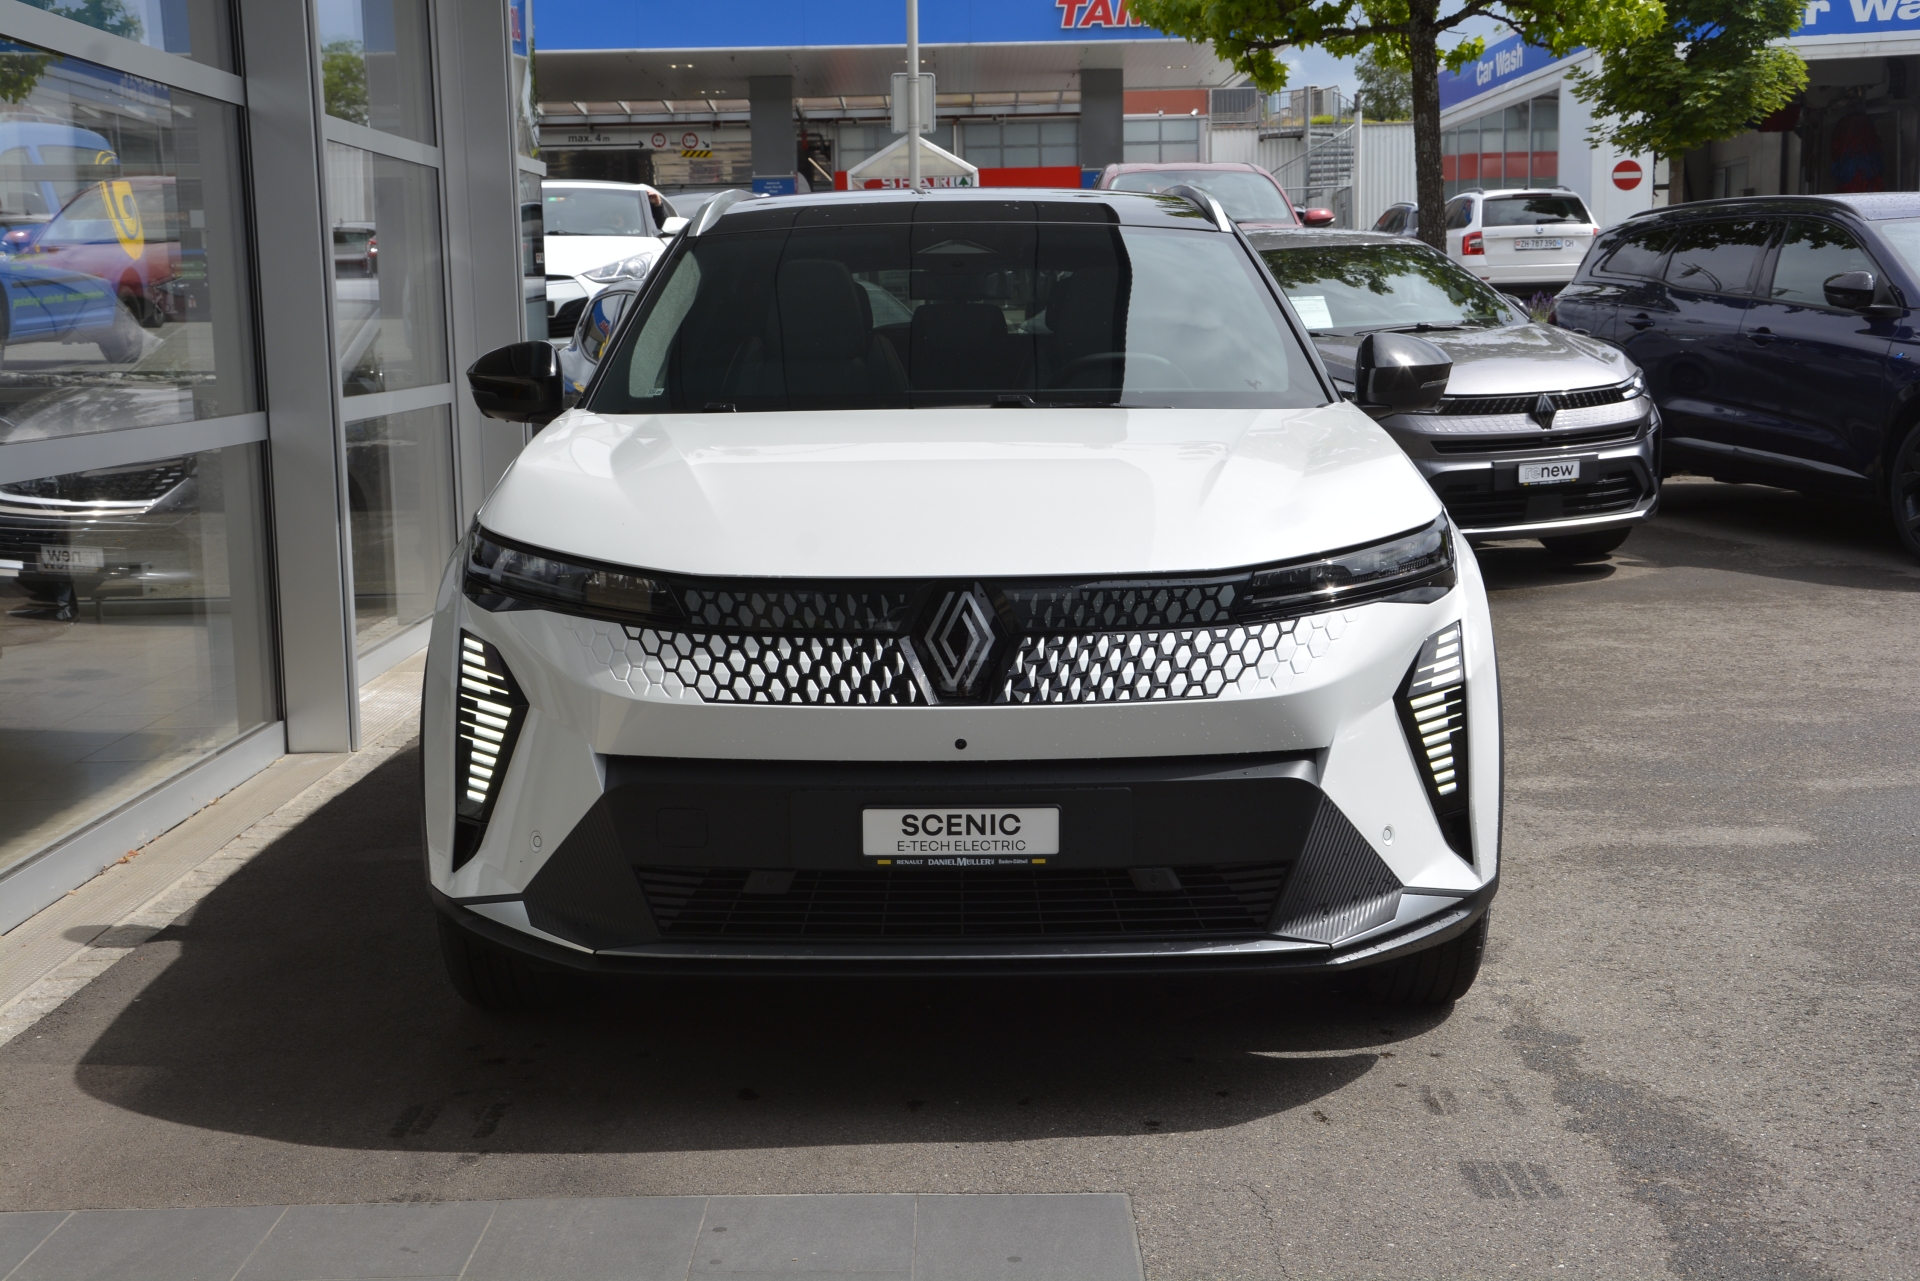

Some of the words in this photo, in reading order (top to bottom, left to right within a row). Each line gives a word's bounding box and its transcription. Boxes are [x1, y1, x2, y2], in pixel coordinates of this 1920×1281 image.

[1476, 60, 1494, 86] Car
[1495, 42, 1523, 77] Wash
[568, 135, 593, 143] max.
[1564, 240, 1574, 248] CH
[1525, 464, 1574, 480] renew
[901, 813, 1021, 836] SCENIC
[897, 840, 950, 852] E-TECH
[955, 840, 1026, 852] ELECTRIC
